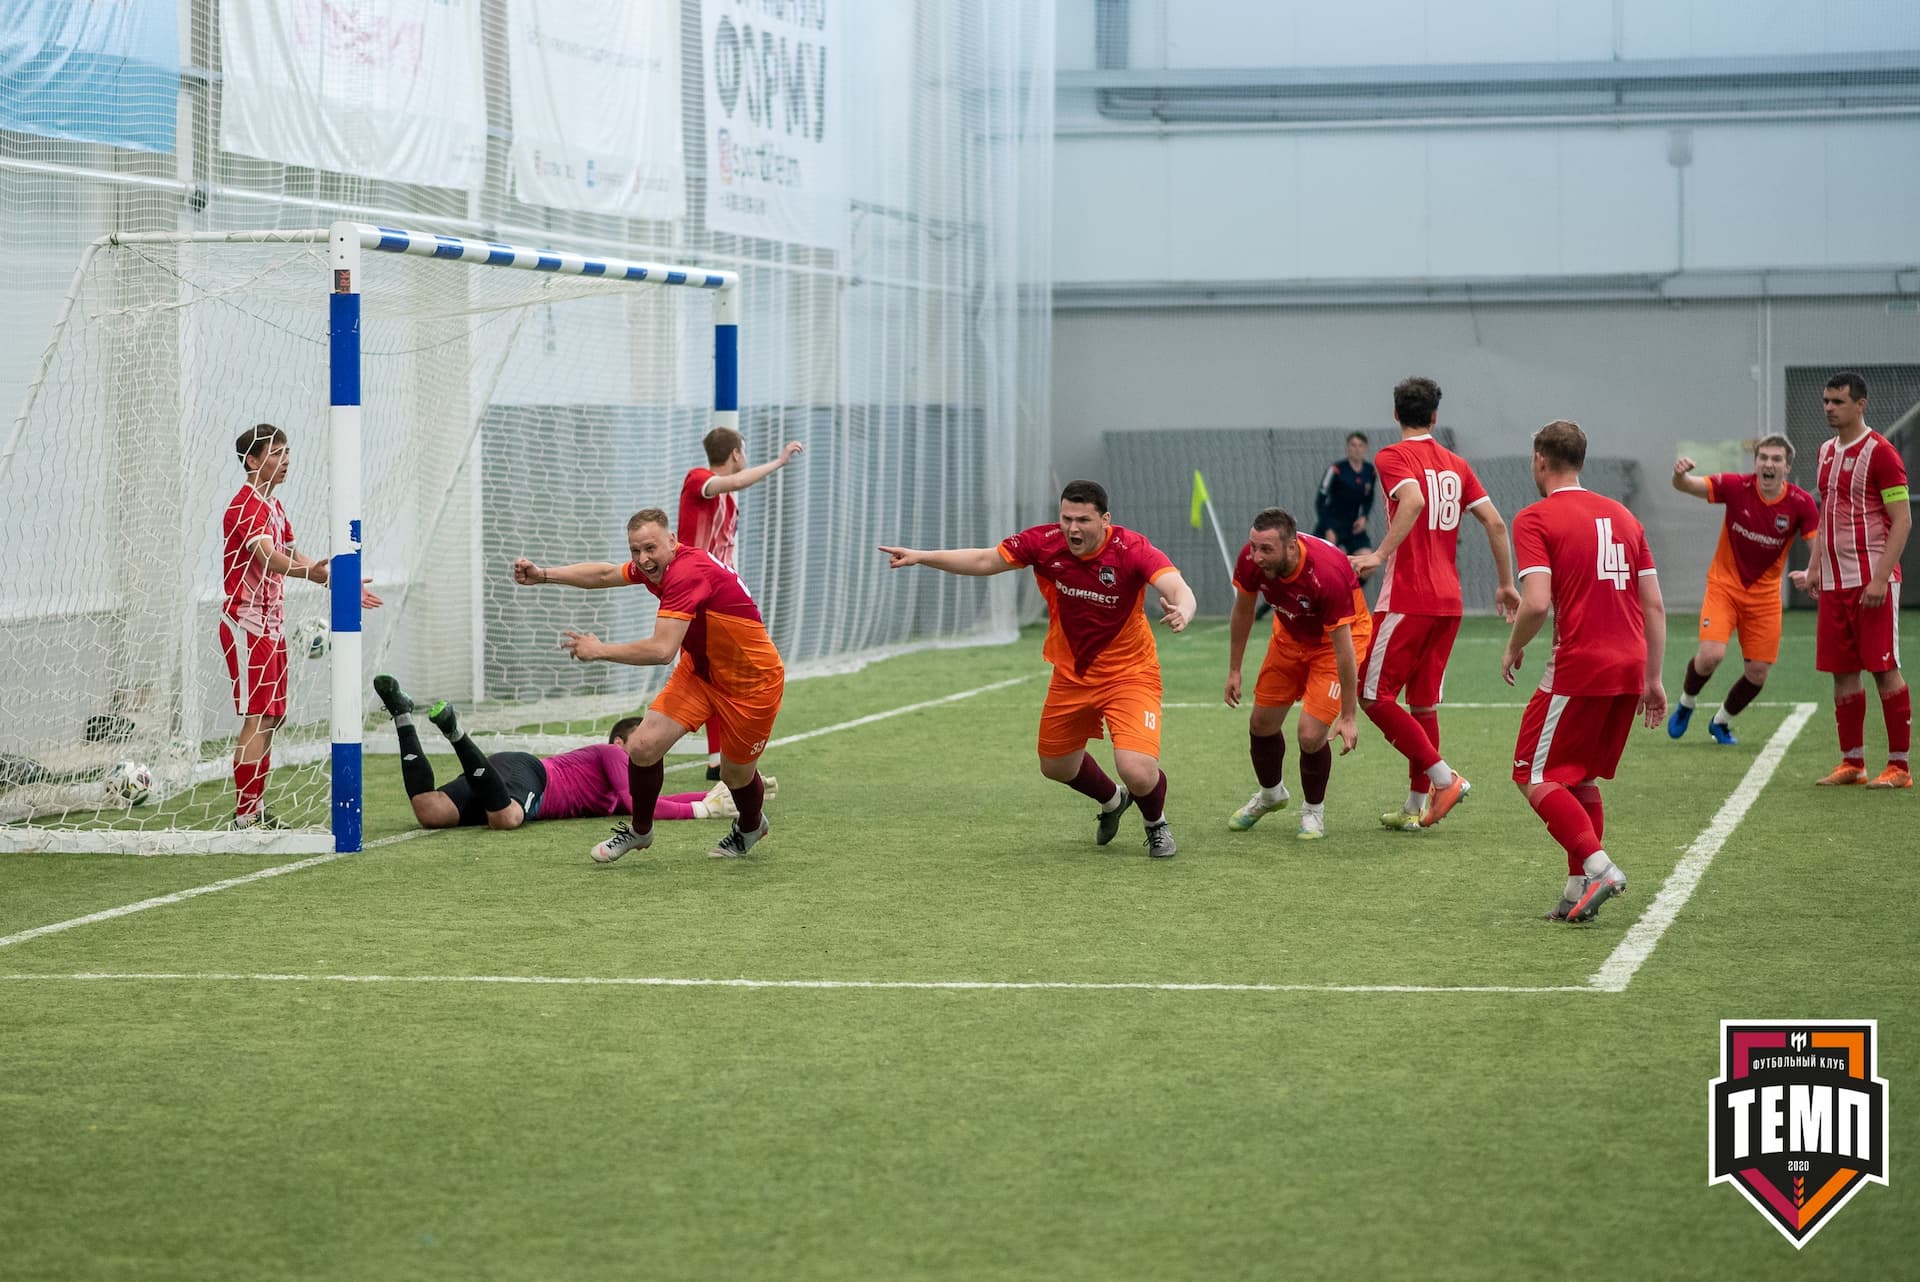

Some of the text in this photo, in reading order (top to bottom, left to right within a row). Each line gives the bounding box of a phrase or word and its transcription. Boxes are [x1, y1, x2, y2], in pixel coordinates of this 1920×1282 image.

[1424, 468, 1463, 532] 18
[1595, 517, 1631, 591] 4
[1328, 680, 1341, 700] 10
[1143, 710, 1156, 730] 13
